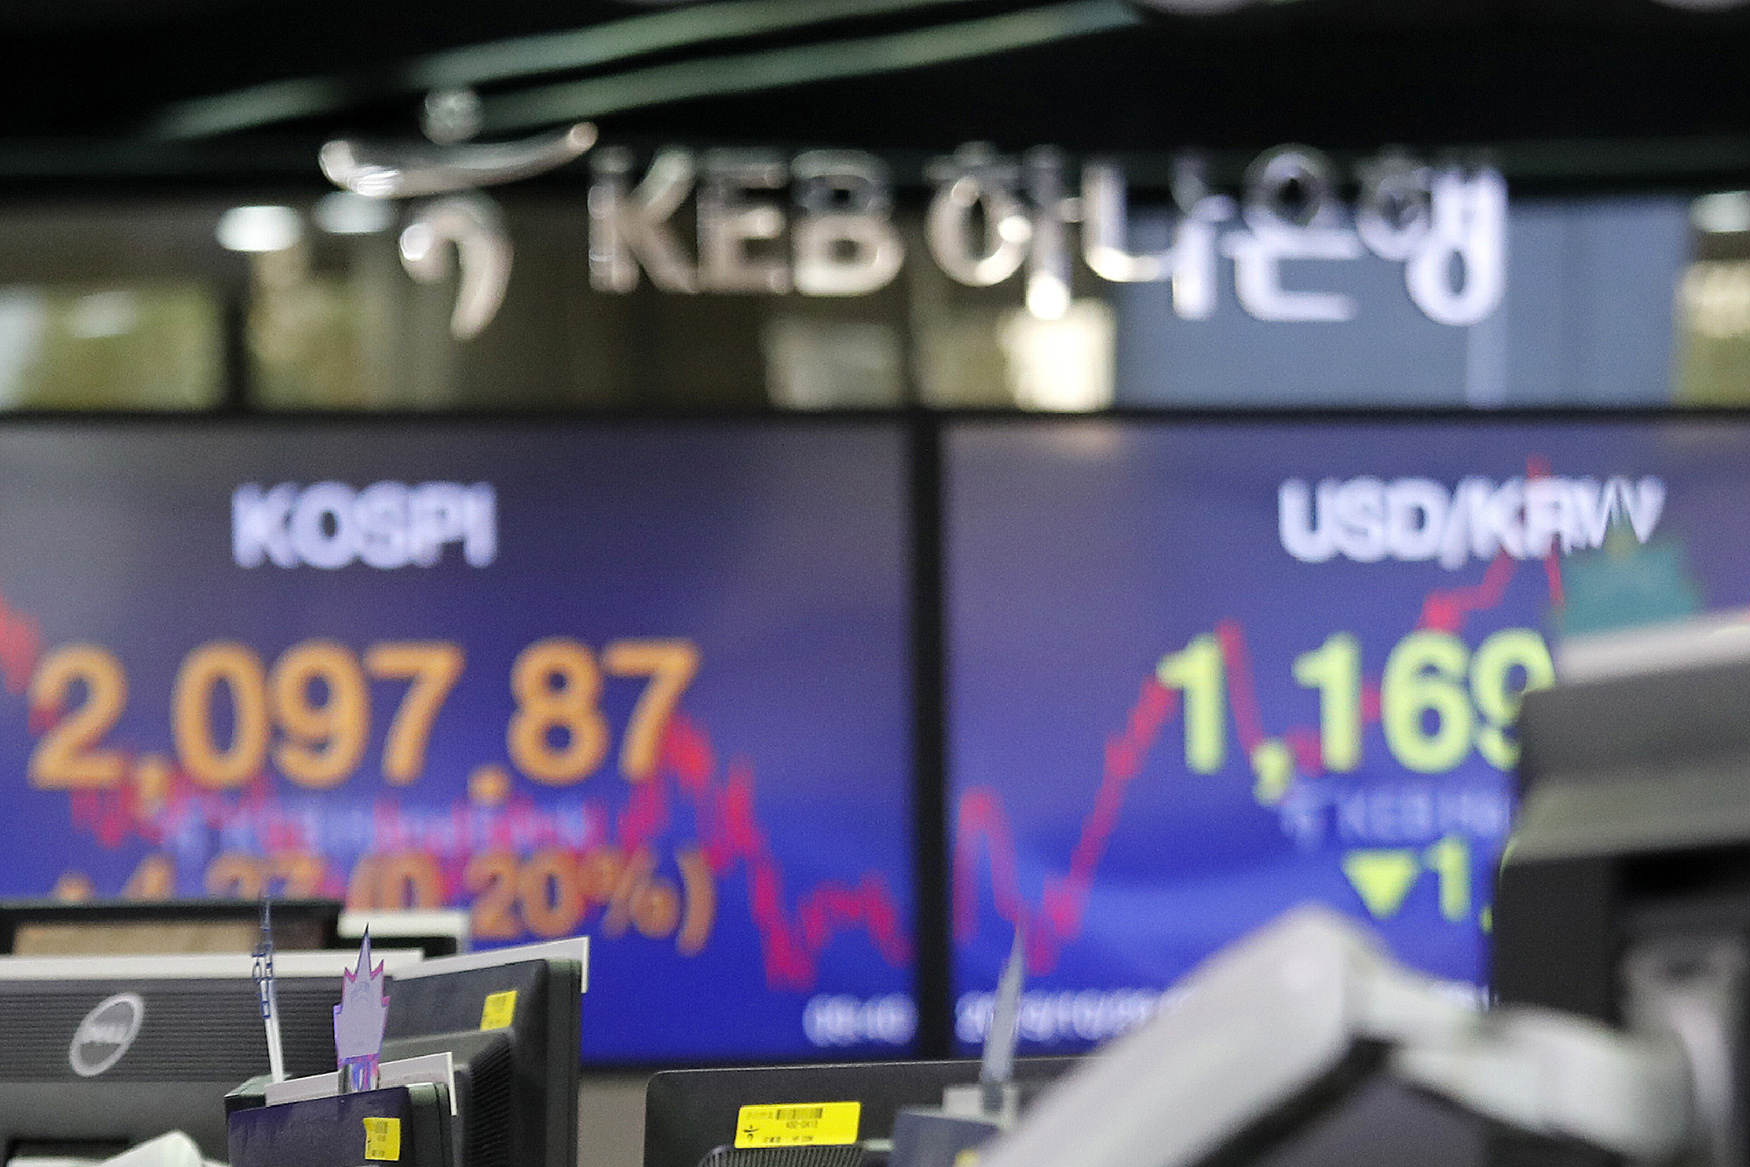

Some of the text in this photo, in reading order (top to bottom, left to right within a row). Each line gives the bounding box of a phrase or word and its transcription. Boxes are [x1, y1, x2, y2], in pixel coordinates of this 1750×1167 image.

[588, 141, 1508, 327] KEB 하나은행
[232, 481, 496, 567] KOSPI
[1277, 474, 1665, 568] USD/KRW
[27, 637, 700, 816] 2,097.87
